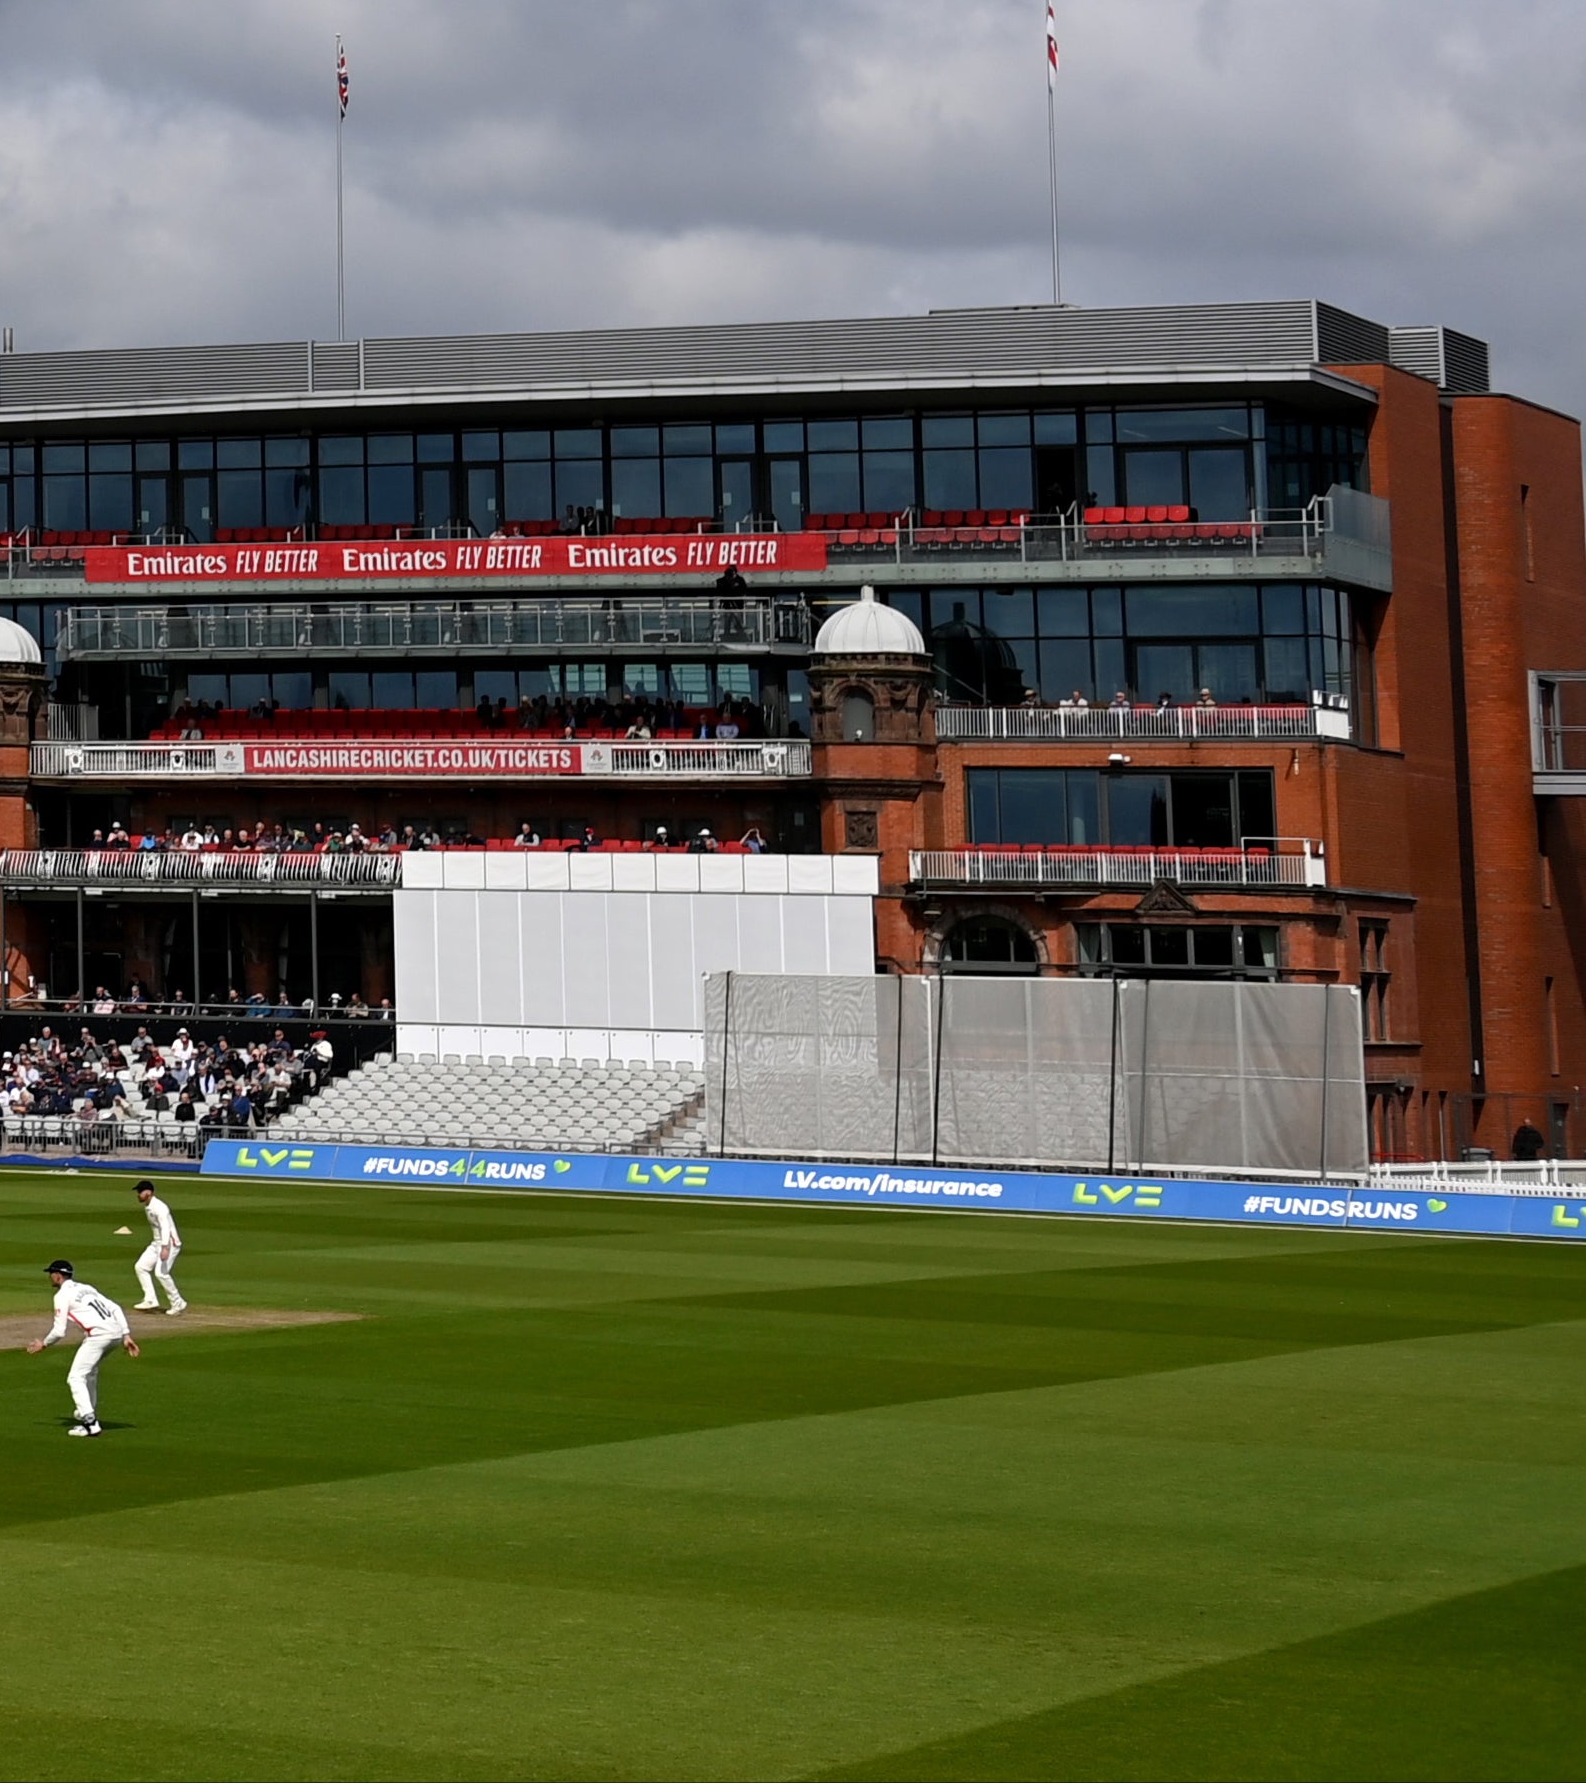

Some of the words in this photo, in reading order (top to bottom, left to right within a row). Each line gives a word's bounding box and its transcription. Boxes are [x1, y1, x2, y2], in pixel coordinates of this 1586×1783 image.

[128, 552, 226, 575] Emirates
[236, 551, 260, 573] FLY
[265, 549, 318, 572] BETTER
[343, 548, 446, 571] Emirates
[456, 546, 482, 569] FLY
[486, 545, 542, 569] BETTER
[569, 543, 676, 567] Emirates
[687, 542, 714, 565] FLY
[718, 540, 777, 564] BETTER
[252, 748, 572, 771] LANCASHIRECRICKET.CO.UK/TICKETS
